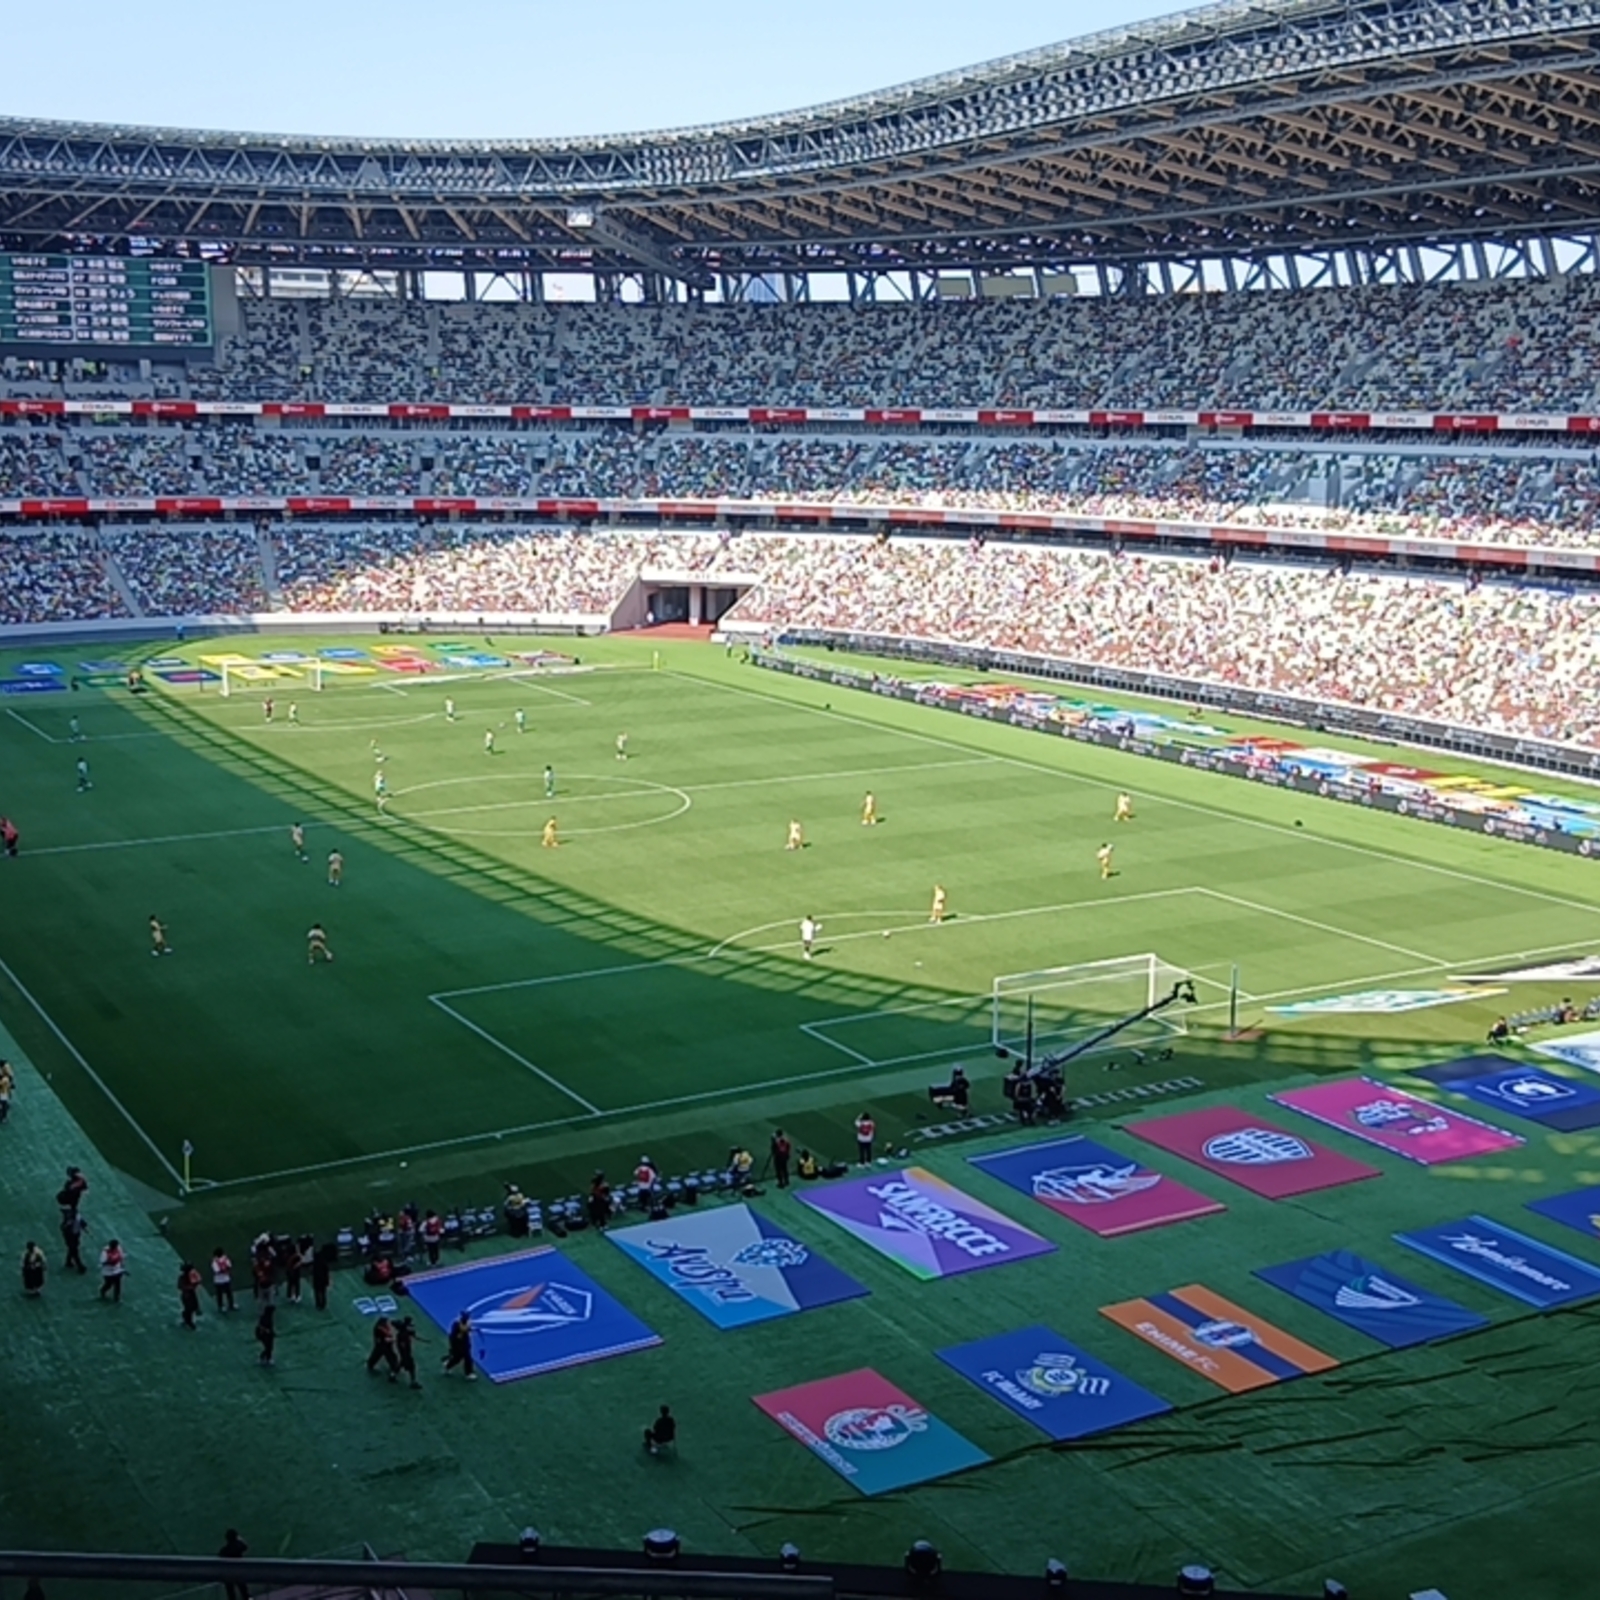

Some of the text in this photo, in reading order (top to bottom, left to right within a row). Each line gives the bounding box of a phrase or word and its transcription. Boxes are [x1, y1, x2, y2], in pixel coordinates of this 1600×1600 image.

[867, 1182, 1010, 1257] SANFRECCE
[1135, 1321, 1220, 1372] EHIME FC
[981, 1370, 1004, 1383] FC
